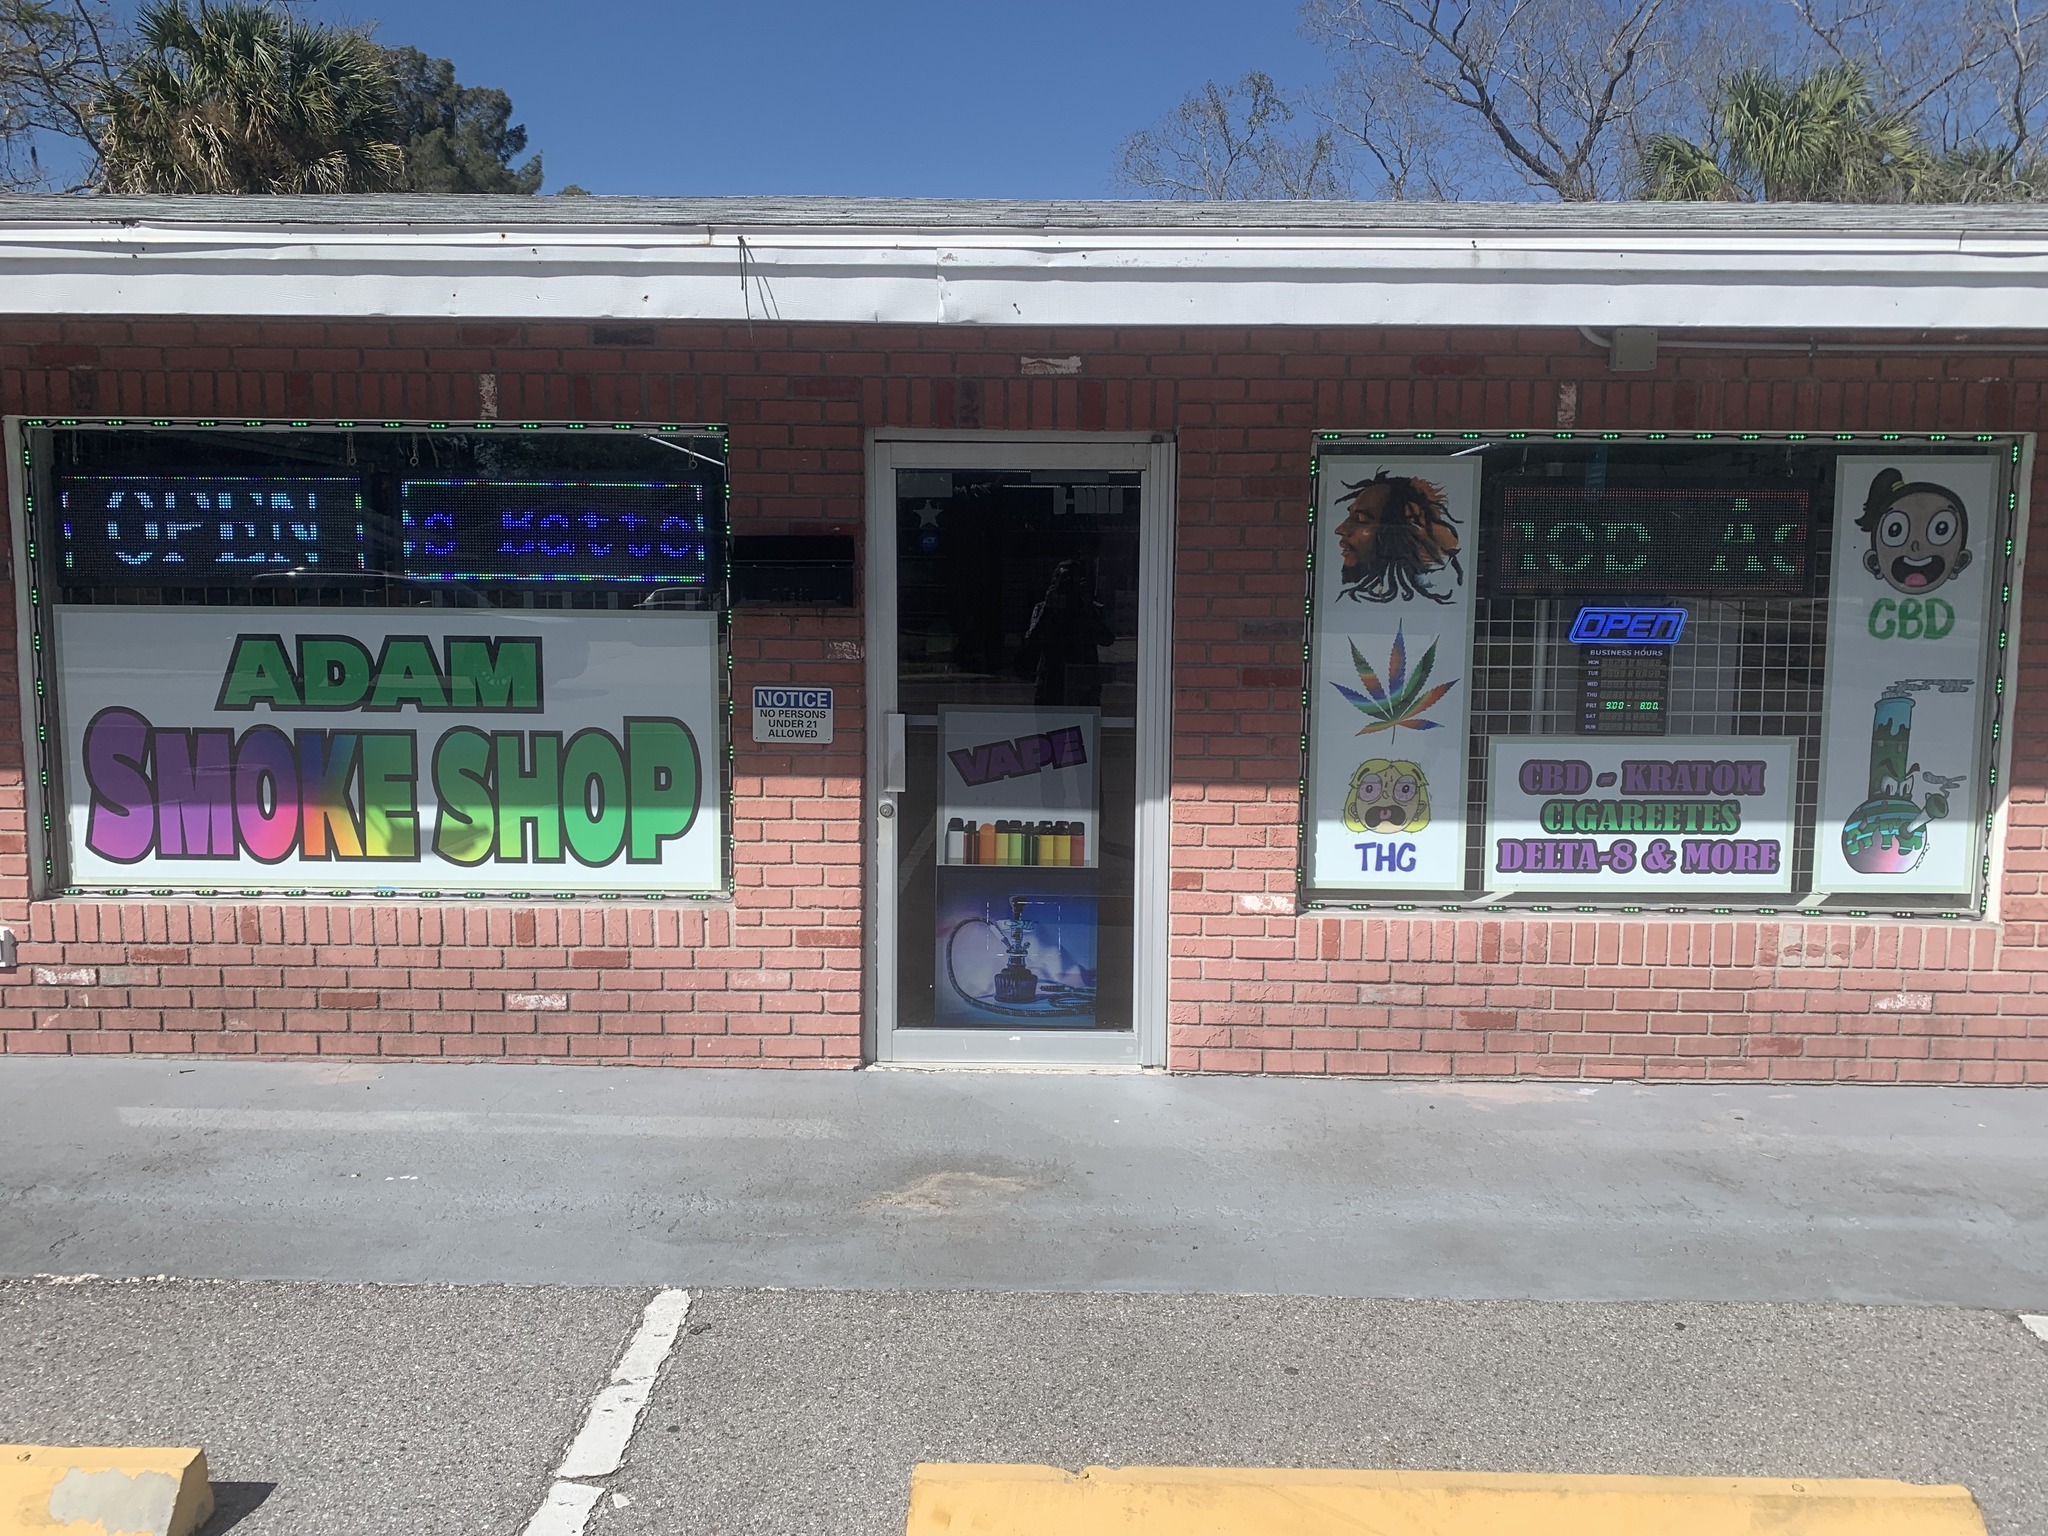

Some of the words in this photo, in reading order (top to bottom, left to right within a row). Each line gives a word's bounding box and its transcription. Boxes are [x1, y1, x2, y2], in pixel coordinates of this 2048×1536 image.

[106, 491, 318, 565] OPEN
[1577, 613, 1680, 638] OPEN
[1868, 597, 1956, 640] CBD
[214, 633, 544, 714] ADAM
[758, 690, 828, 708] NOTICE
[760, 709, 776, 718] NO
[778, 709, 827, 719] PERSONS
[768, 719, 804, 728] UNDER
[806, 720, 817, 728] 21
[768, 729, 818, 738] ALLOWED
[947, 725, 1088, 788] VAPE
[82, 706, 422, 866] SMOKE
[431, 716, 703, 868] SHOP
[1519, 759, 1593, 795] CBD
[1620, 760, 1767, 796] KRATOM
[1540, 799, 1741, 835] CIGAREETES
[1354, 841, 1417, 872] THC
[1496, 838, 1637, 874] DELTA-8
[1641, 838, 1677, 874] &
[1680, 839, 1782, 875] MORE
